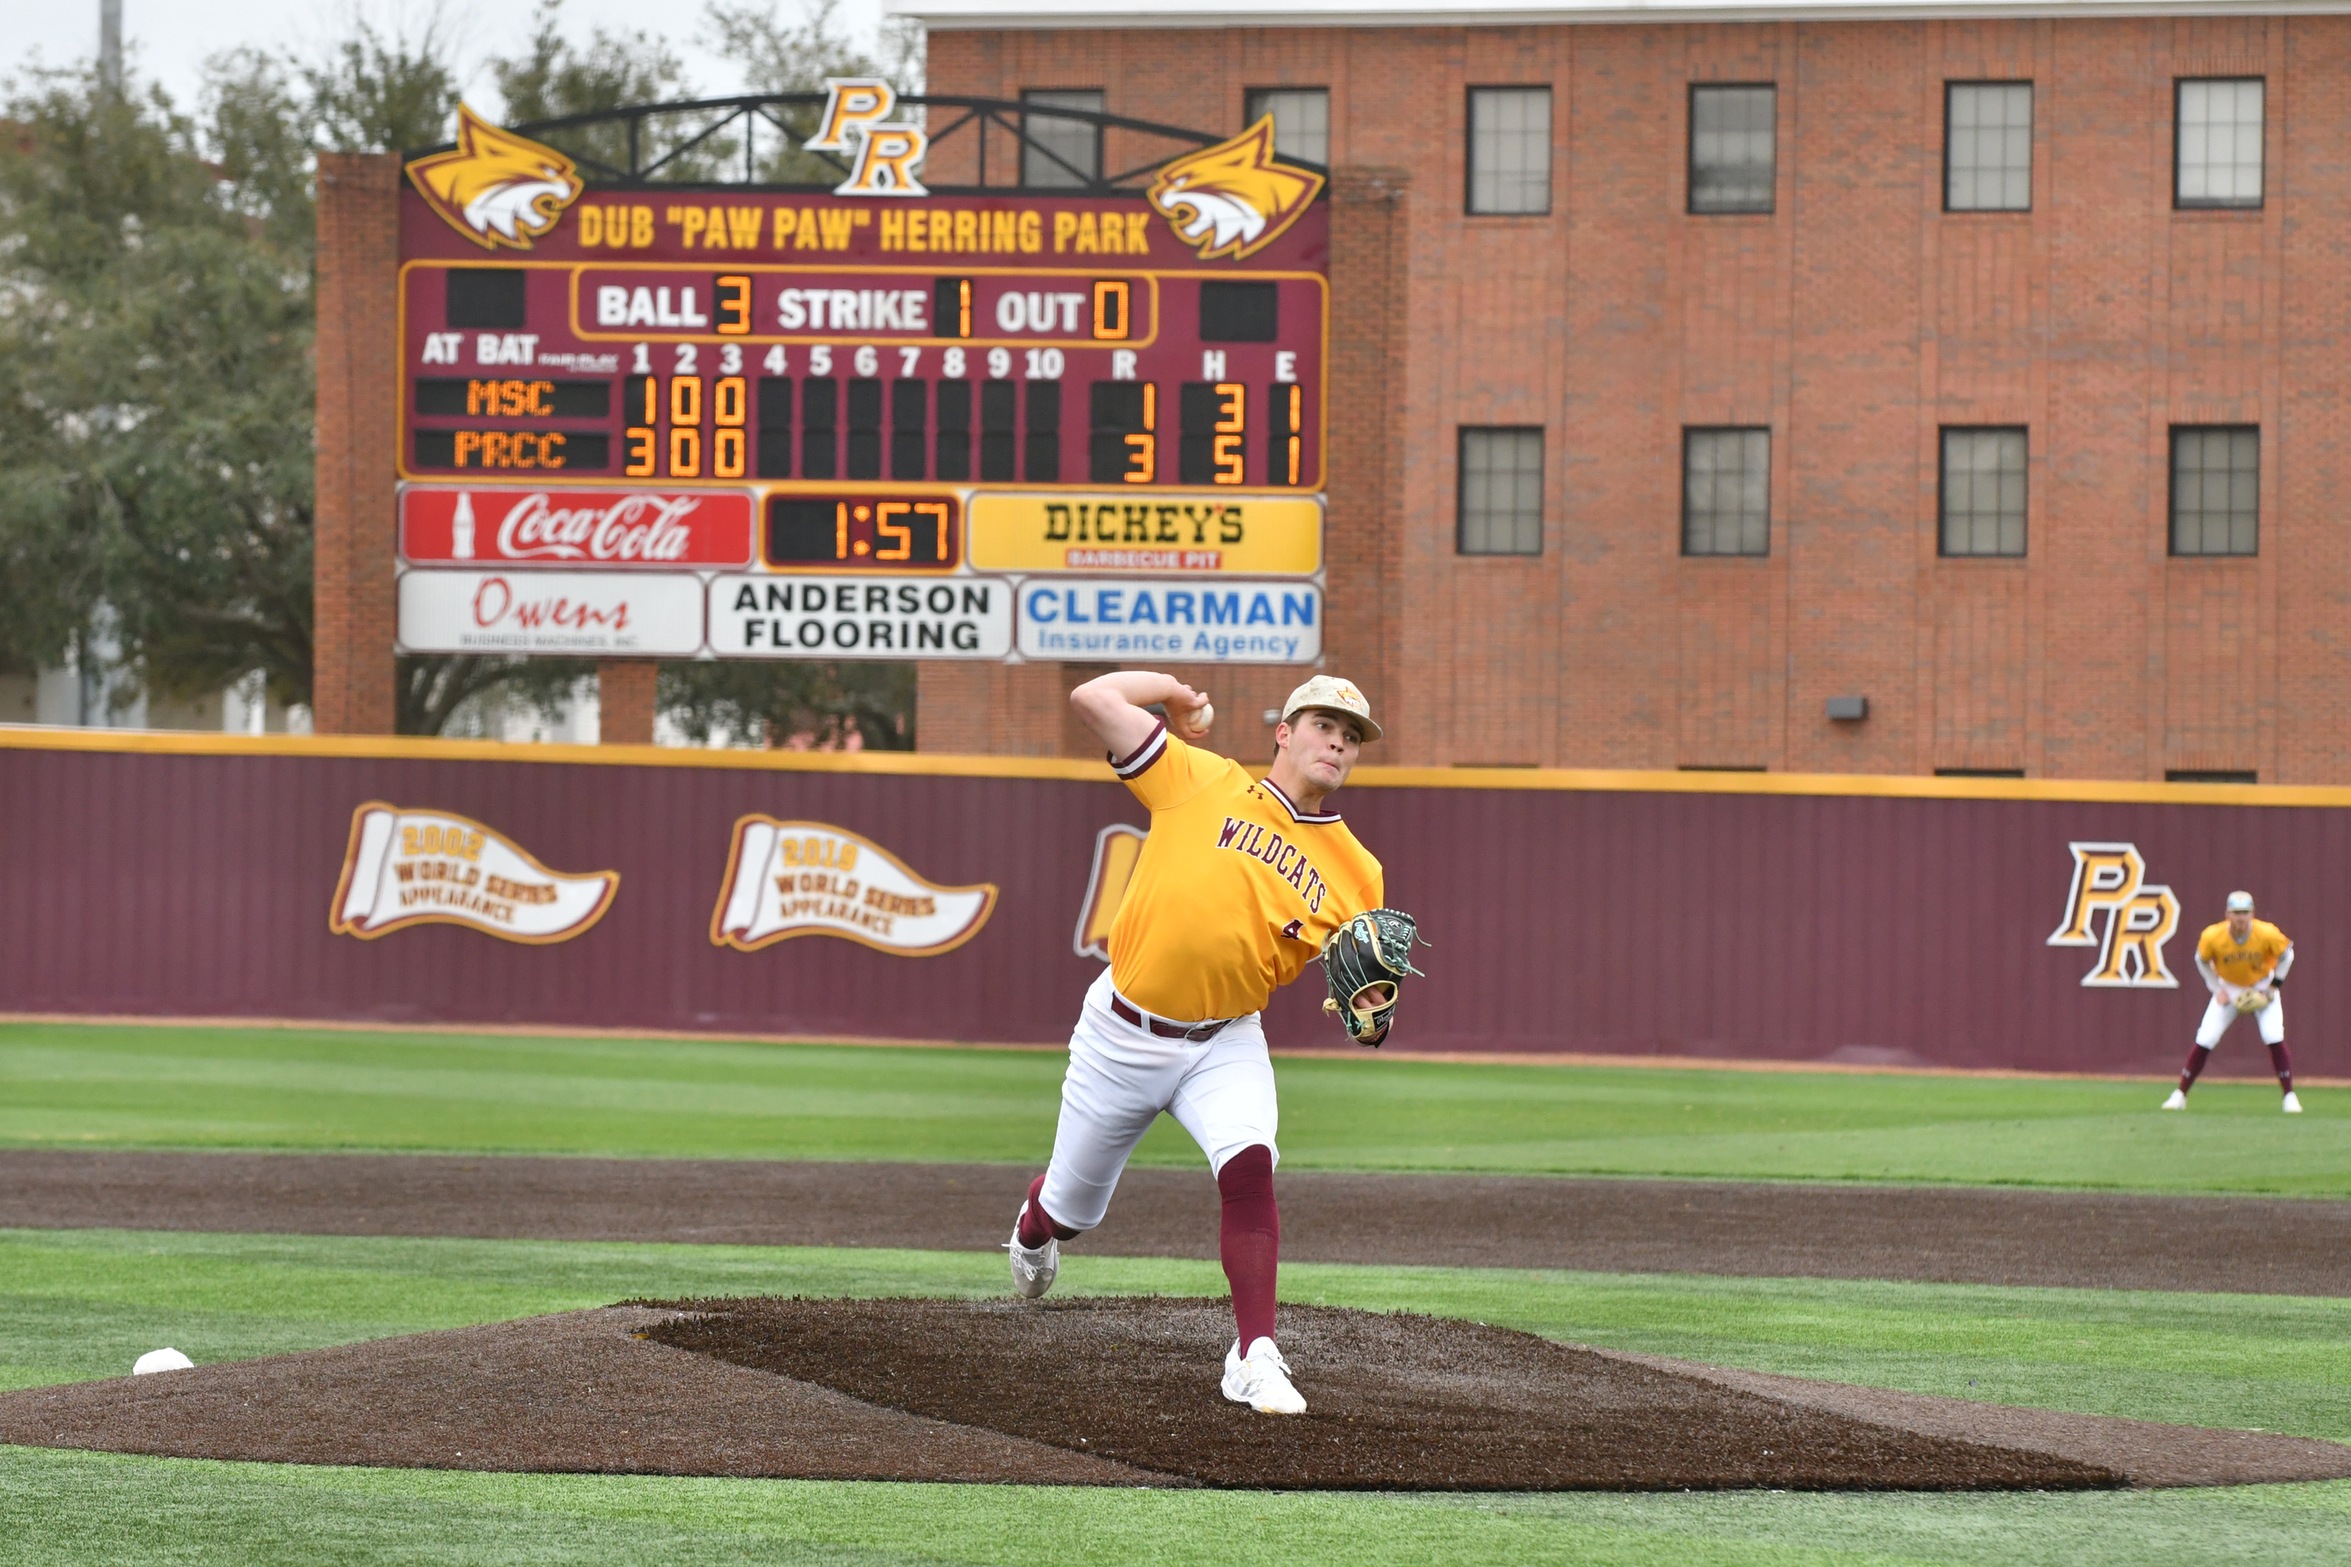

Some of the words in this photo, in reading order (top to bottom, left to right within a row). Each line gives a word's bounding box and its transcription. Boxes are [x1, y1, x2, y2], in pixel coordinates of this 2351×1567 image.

[578, 205, 654, 248] DUB
[667, 206, 763, 249] "PAW
[773, 207, 871, 250] PAW"
[880, 209, 1043, 253] HERRING
[1054, 211, 1150, 255] PARK
[597, 285, 707, 328] BALL
[716, 275, 751, 334] 3
[777, 288, 928, 330] STRIKE
[960, 279, 971, 338] 1
[996, 291, 1086, 333] OUT
[1094, 281, 1129, 339] 0
[421, 333, 464, 365] AT
[476, 334, 540, 365] BAT
[632, 343, 652, 374] 1
[675, 343, 699, 375] 2
[719, 343, 743, 375] 3
[763, 344, 788, 375] 4
[809, 344, 833, 376] 5
[853, 345, 879, 377] 6
[898, 346, 921, 377] 7
[942, 346, 967, 378] 8
[987, 347, 1012, 379] 9
[1025, 348, 1065, 379] 10
[1112, 349, 1138, 379] R
[1203, 350, 1227, 380] H
[1275, 351, 1297, 382] E
[467, 379, 555, 416] MSC
[1143, 382, 1155, 431] 1
[1214, 384, 1245, 432] 3
[1289, 385, 1301, 433] 1
[454, 430, 566, 468] PRCC
[1124, 434, 1155, 483] 3
[1214, 435, 1244, 484] 5
[1288, 436, 1300, 485] 1
[497, 492, 701, 560] Coca-Cola
[836, 501, 948, 560] 1:57
[1044, 504, 1243, 543] DICKEY'S
[1068, 551, 1180, 567] BARBECUE
[1185, 552, 1218, 568] PIT
[470, 577, 631, 631] Owens
[735, 583, 989, 615] ANDERSON
[1026, 588, 1314, 626] CLEARMAN
[746, 618, 979, 650] FLOORING
[1039, 629, 1182, 650] Insurance
[1193, 630, 1300, 659] Agency
[402, 825, 486, 863] 2002
[1215, 816, 1327, 914] WILDCATS
[394, 861, 481, 888] WORLD
[775, 873, 859, 899] WORLD
[1280, 918, 1305, 940] 4
